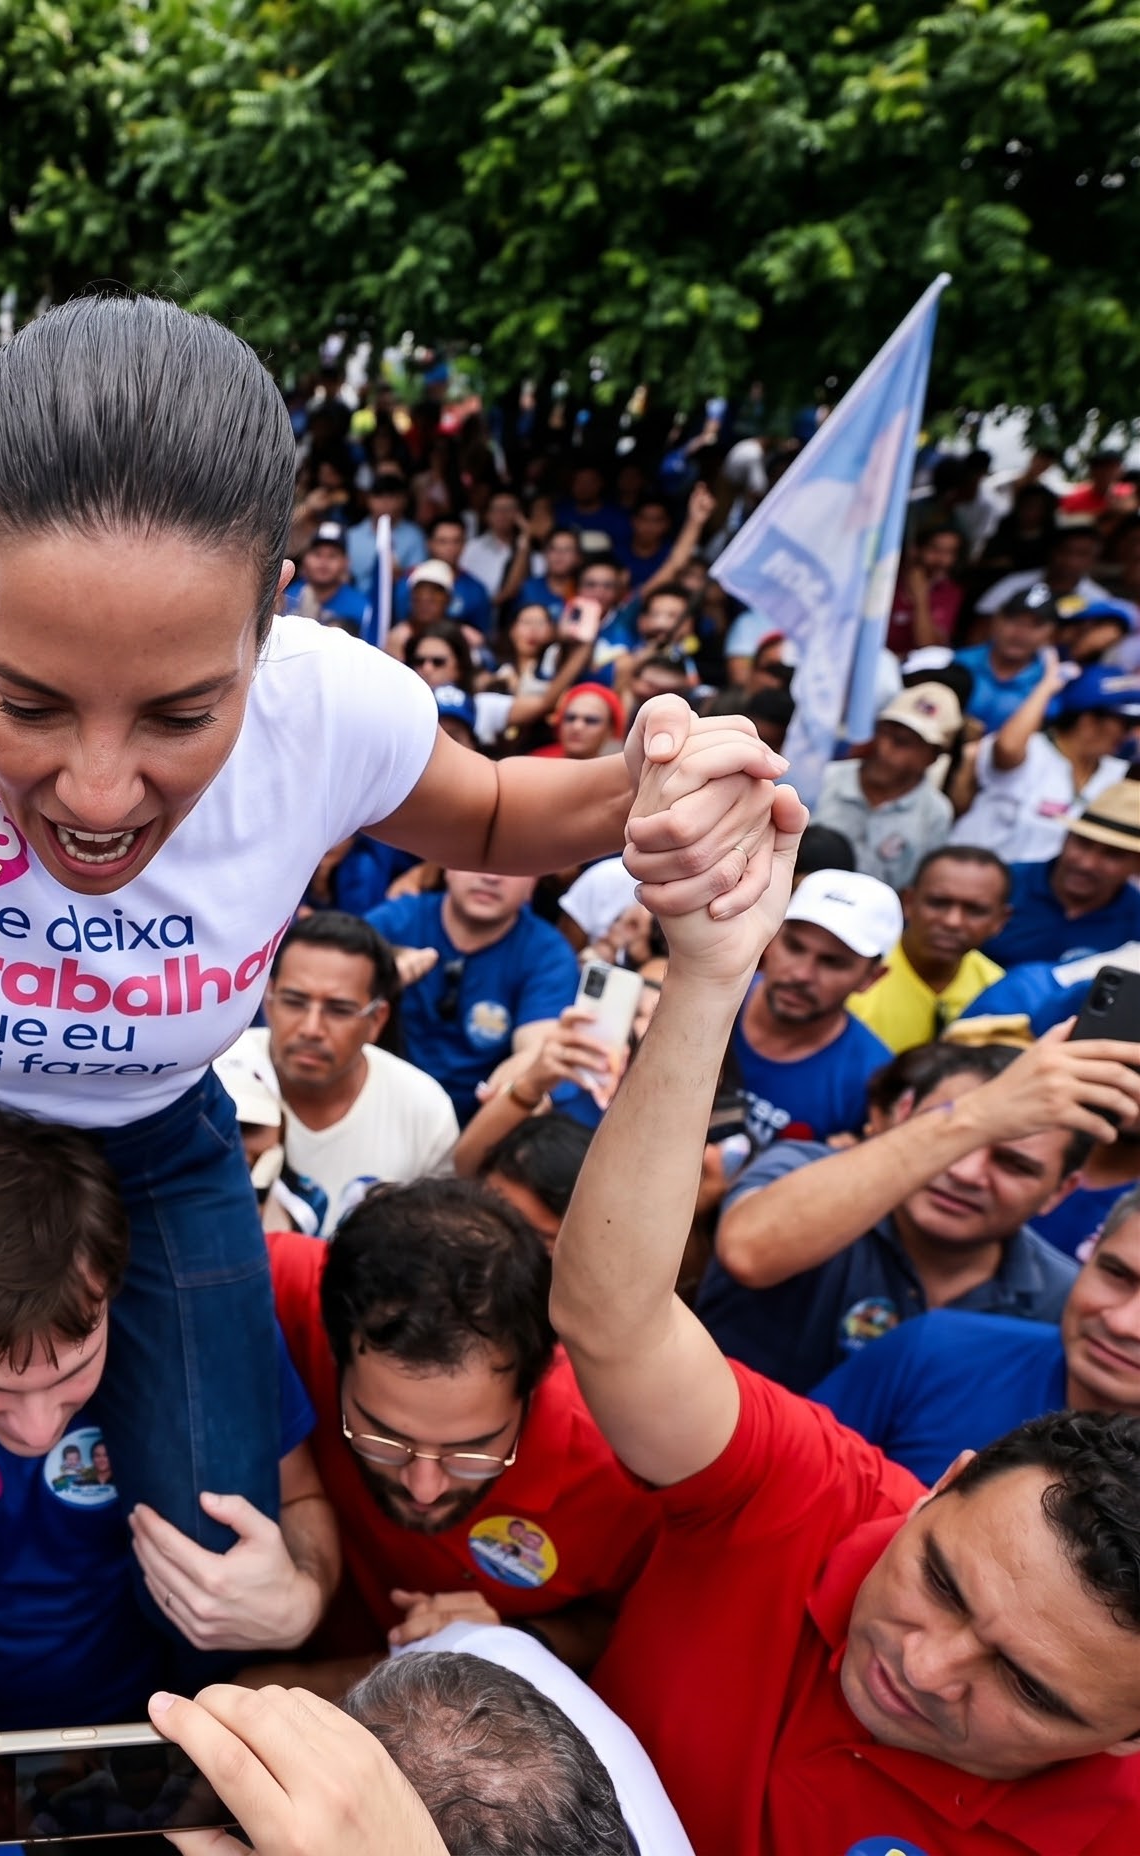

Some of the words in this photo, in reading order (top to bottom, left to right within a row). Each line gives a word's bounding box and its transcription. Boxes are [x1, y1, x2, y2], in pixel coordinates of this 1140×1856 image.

[46, 905, 194, 953] deixa
[62, 1023, 136, 1052] eu
[18, 1053, 178, 1076] fazer
